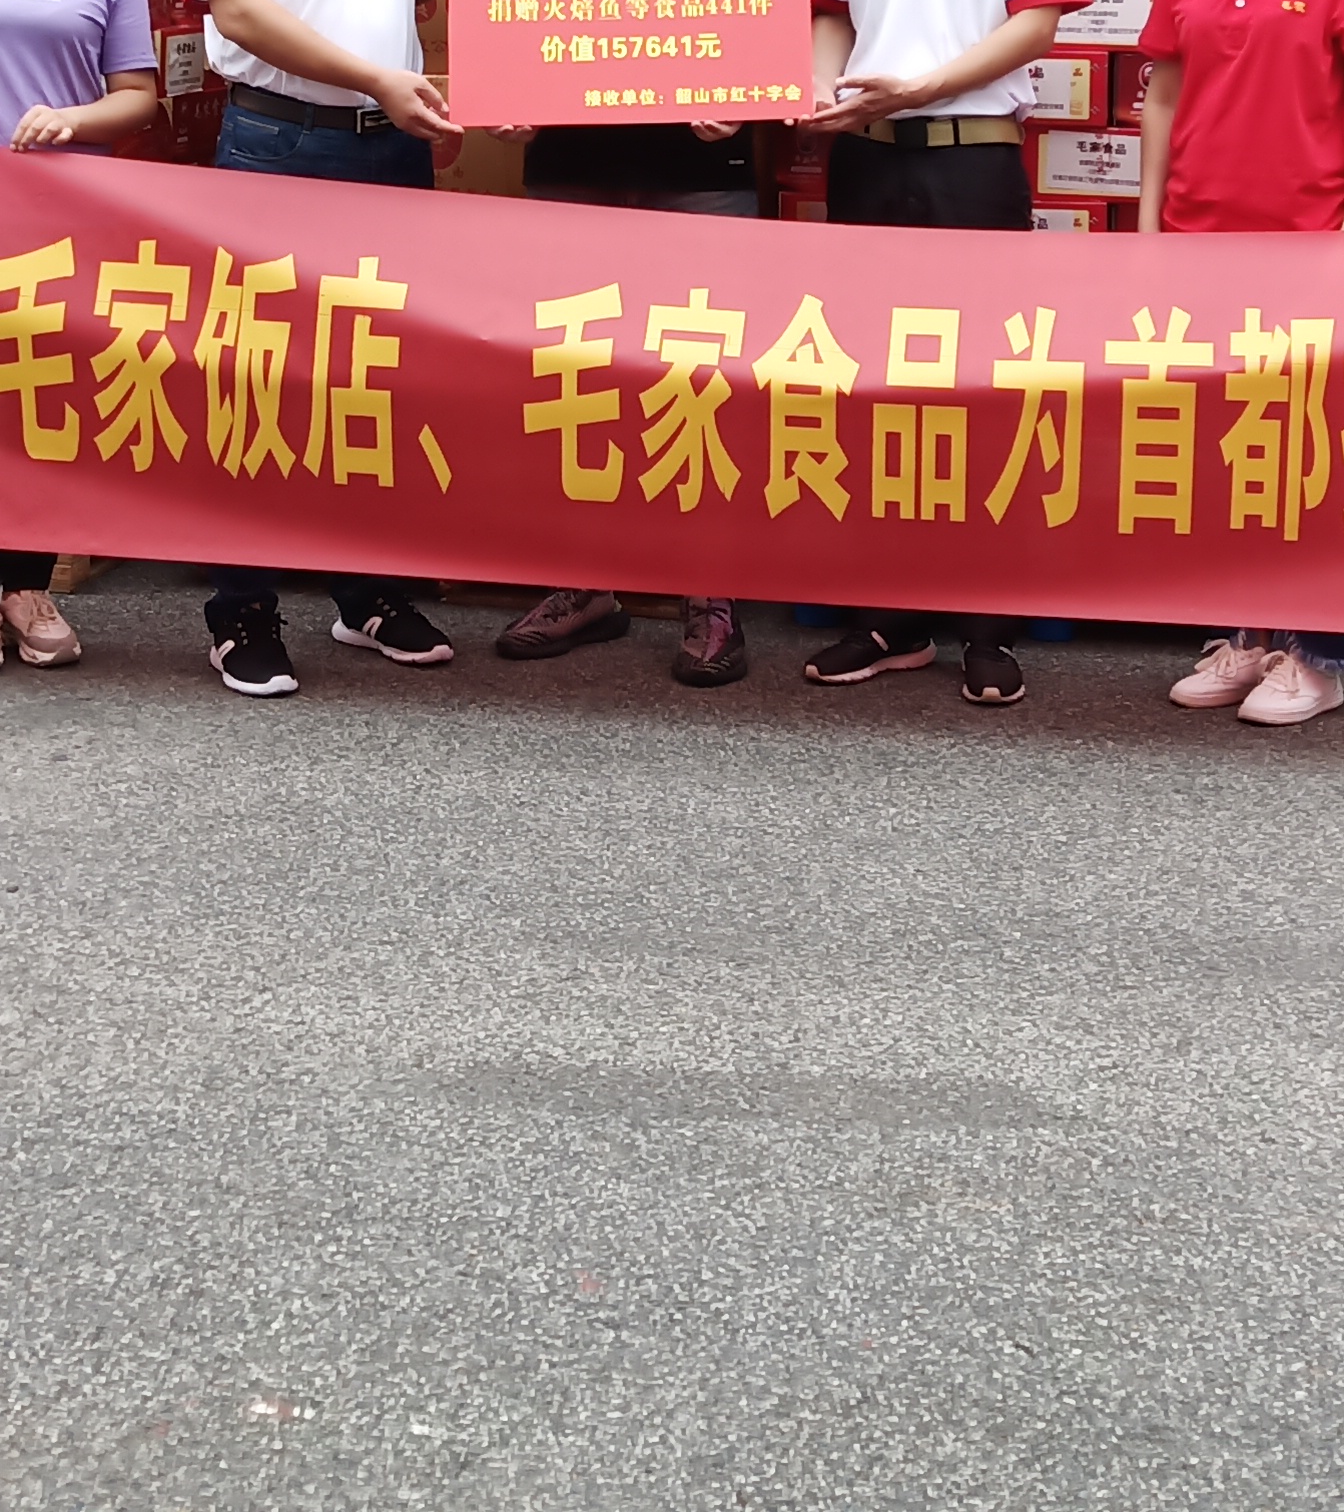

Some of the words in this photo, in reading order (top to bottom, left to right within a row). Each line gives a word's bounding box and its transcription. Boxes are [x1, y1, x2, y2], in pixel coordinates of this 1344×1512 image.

[541, 33, 722, 63] 价值157641元
[676, 85, 802, 106] 韶山市红十字会
